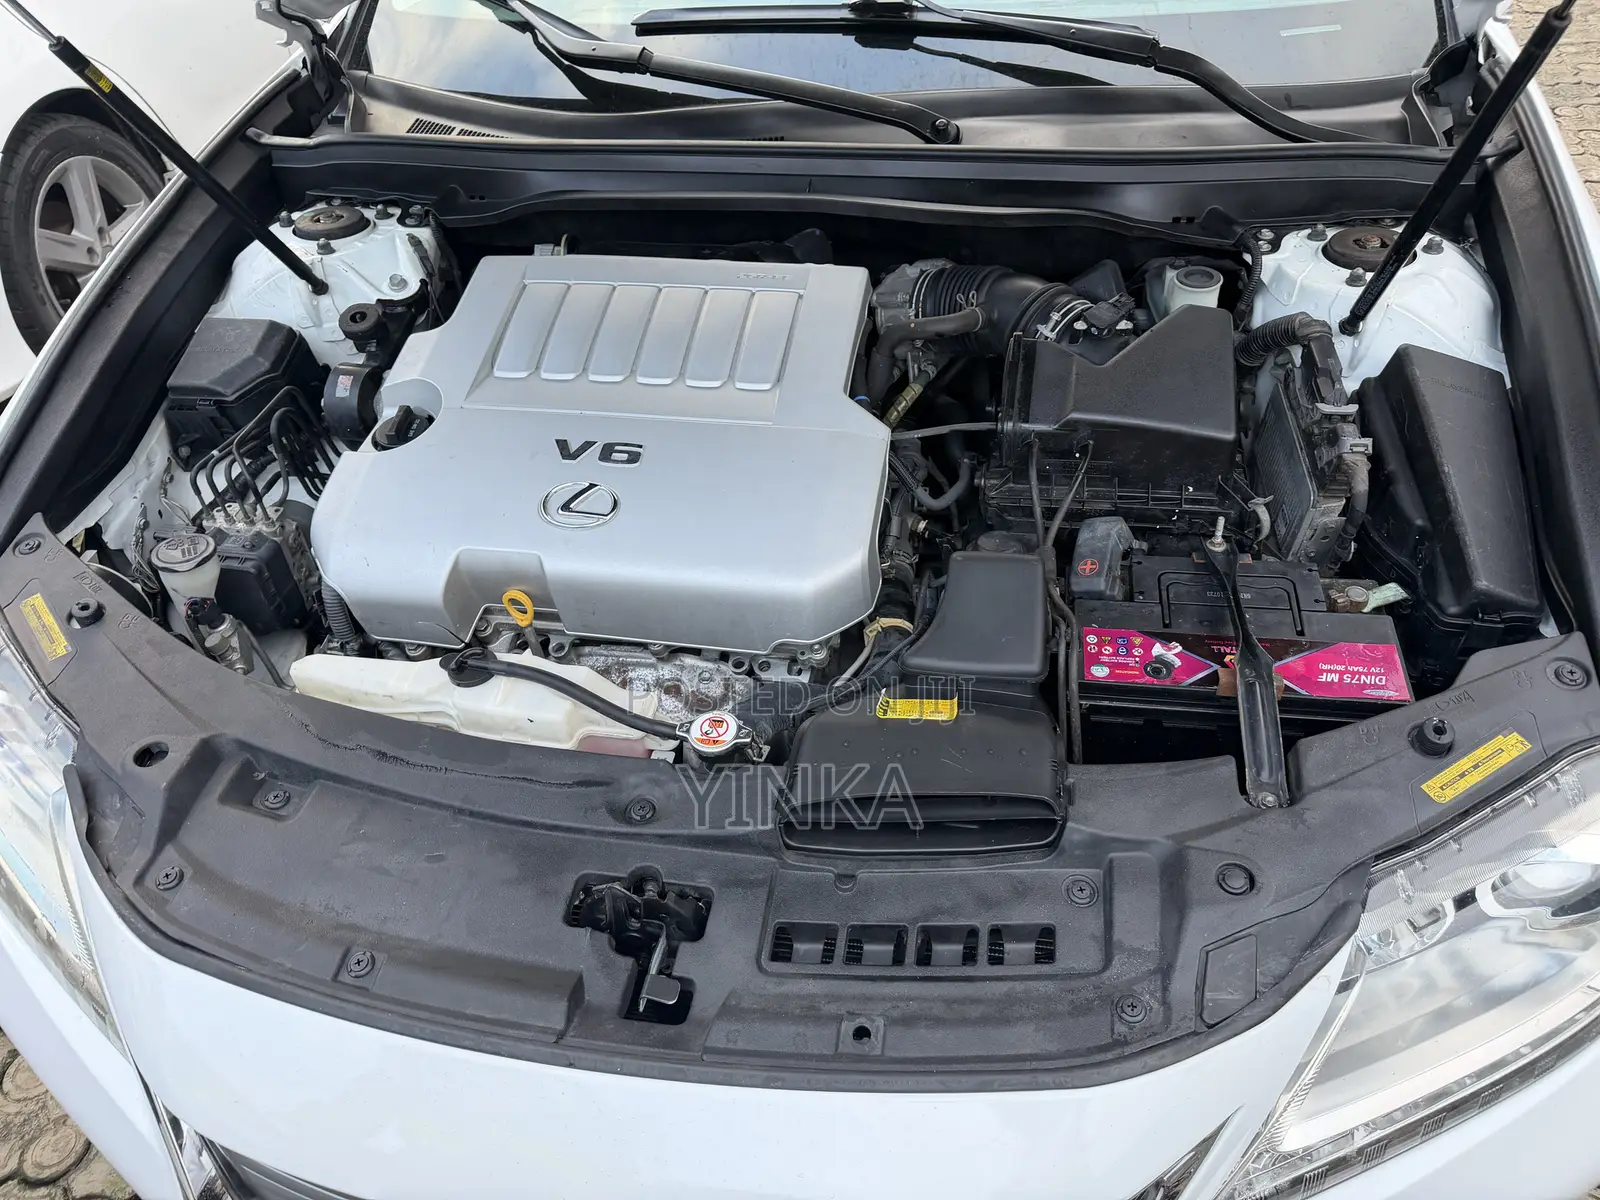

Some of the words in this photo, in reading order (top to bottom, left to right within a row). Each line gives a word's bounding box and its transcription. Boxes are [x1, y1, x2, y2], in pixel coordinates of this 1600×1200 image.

[555, 438, 646, 467] V6
[1319, 663, 1346, 671] 20(HR)
[1317, 673, 1339, 682] MF
[1343, 673, 1386, 685] DIN75
